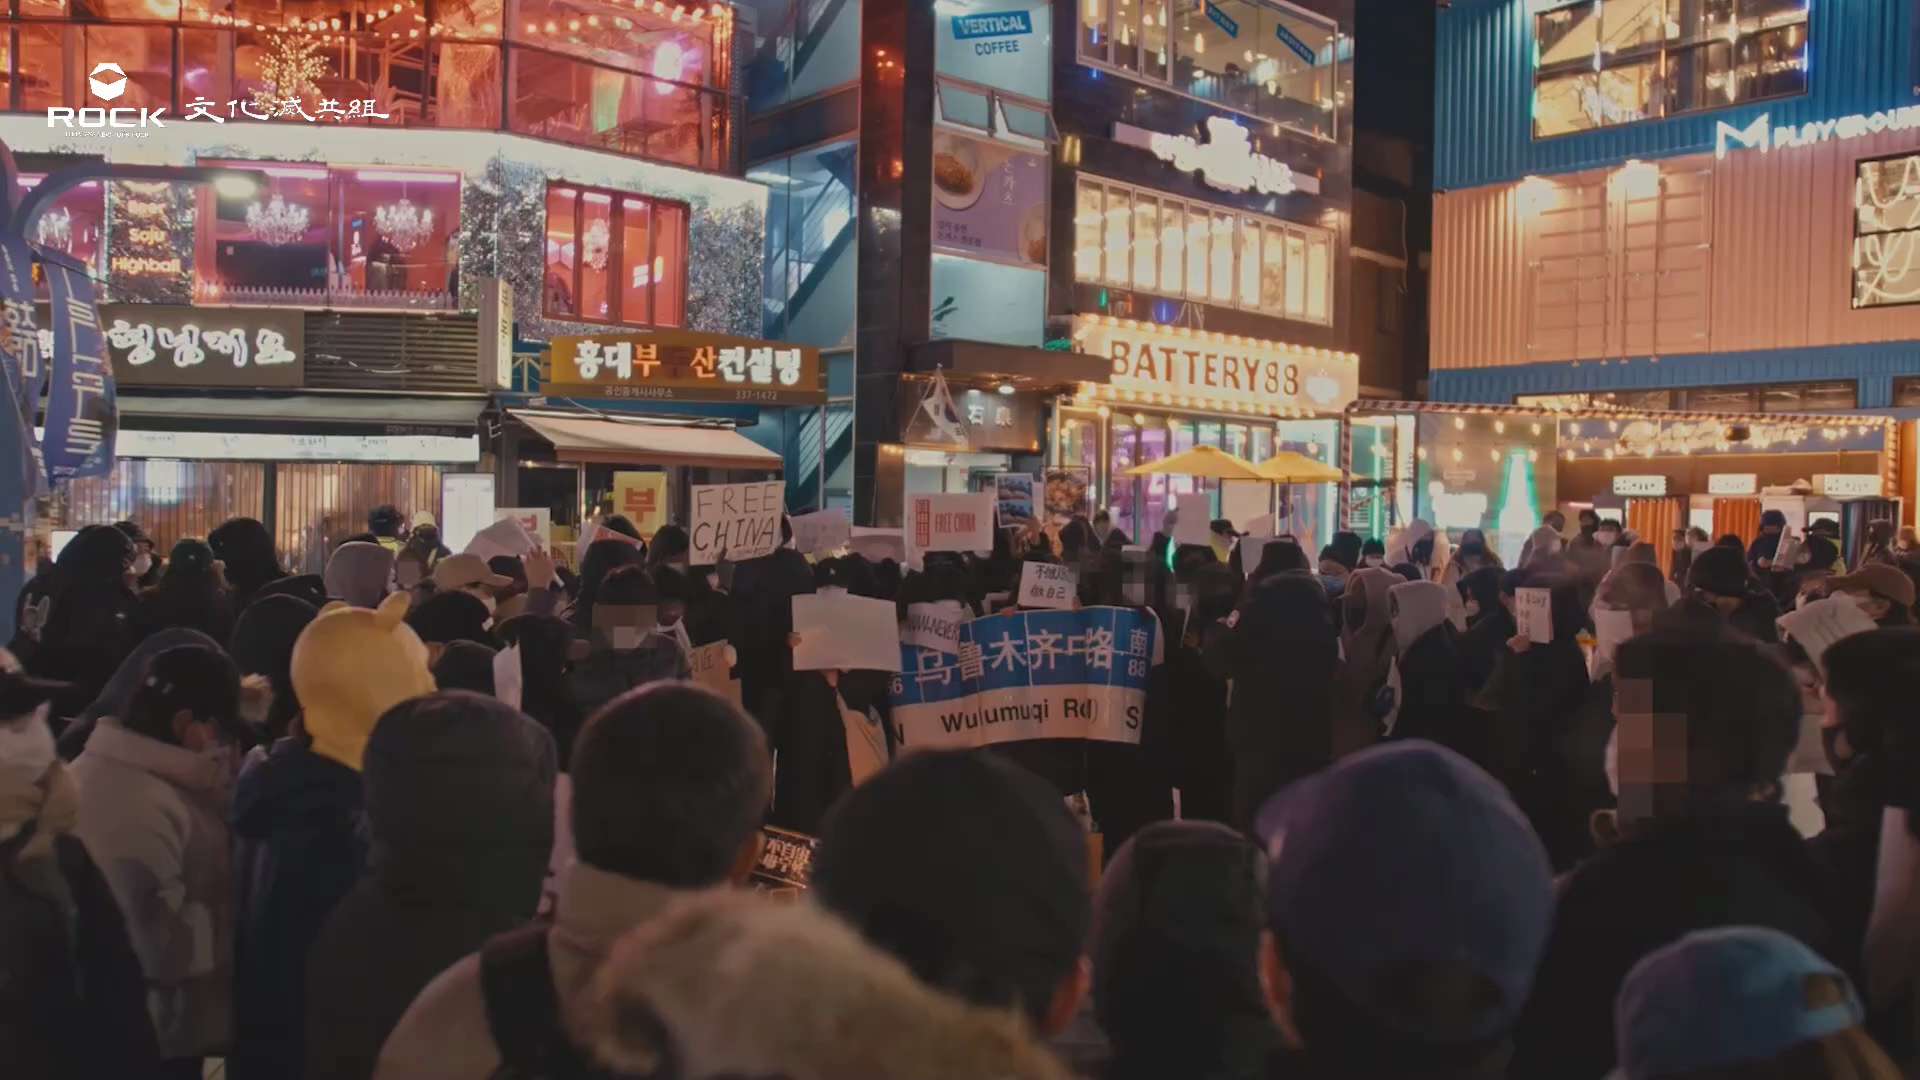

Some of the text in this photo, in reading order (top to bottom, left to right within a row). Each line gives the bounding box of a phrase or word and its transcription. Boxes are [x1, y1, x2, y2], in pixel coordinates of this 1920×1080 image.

[958, 16, 1026, 34] VERTICAL
[975, 40, 1020, 56] COFFEE
[128, 226, 166, 246] Soju
[111, 256, 181, 275] Highball
[573, 340, 801, 385] 홍대부산컨설팅
[696, 483, 778, 518] FREE
[934, 512, 952, 533] FREE
[692, 515, 776, 552] CHINA
[940, 698, 1049, 733] Wulumuqi
[1126, 706, 1139, 730] S
